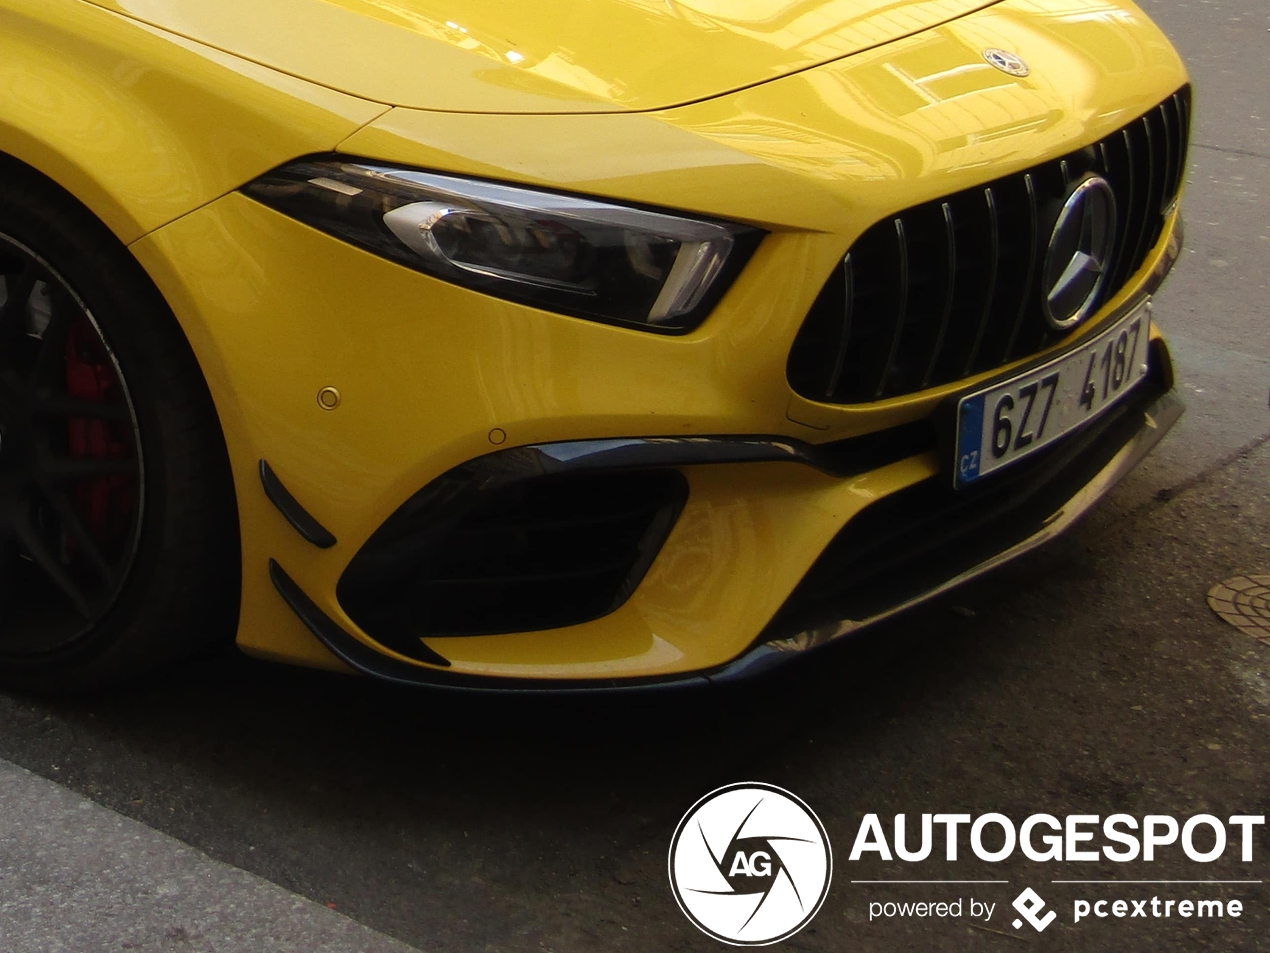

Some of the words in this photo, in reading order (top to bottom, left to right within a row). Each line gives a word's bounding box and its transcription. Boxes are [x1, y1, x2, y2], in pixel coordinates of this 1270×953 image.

[960, 450, 978, 473] CZ
[991, 370, 1060, 459] 6Z7
[1080, 317, 1141, 411] 4187
